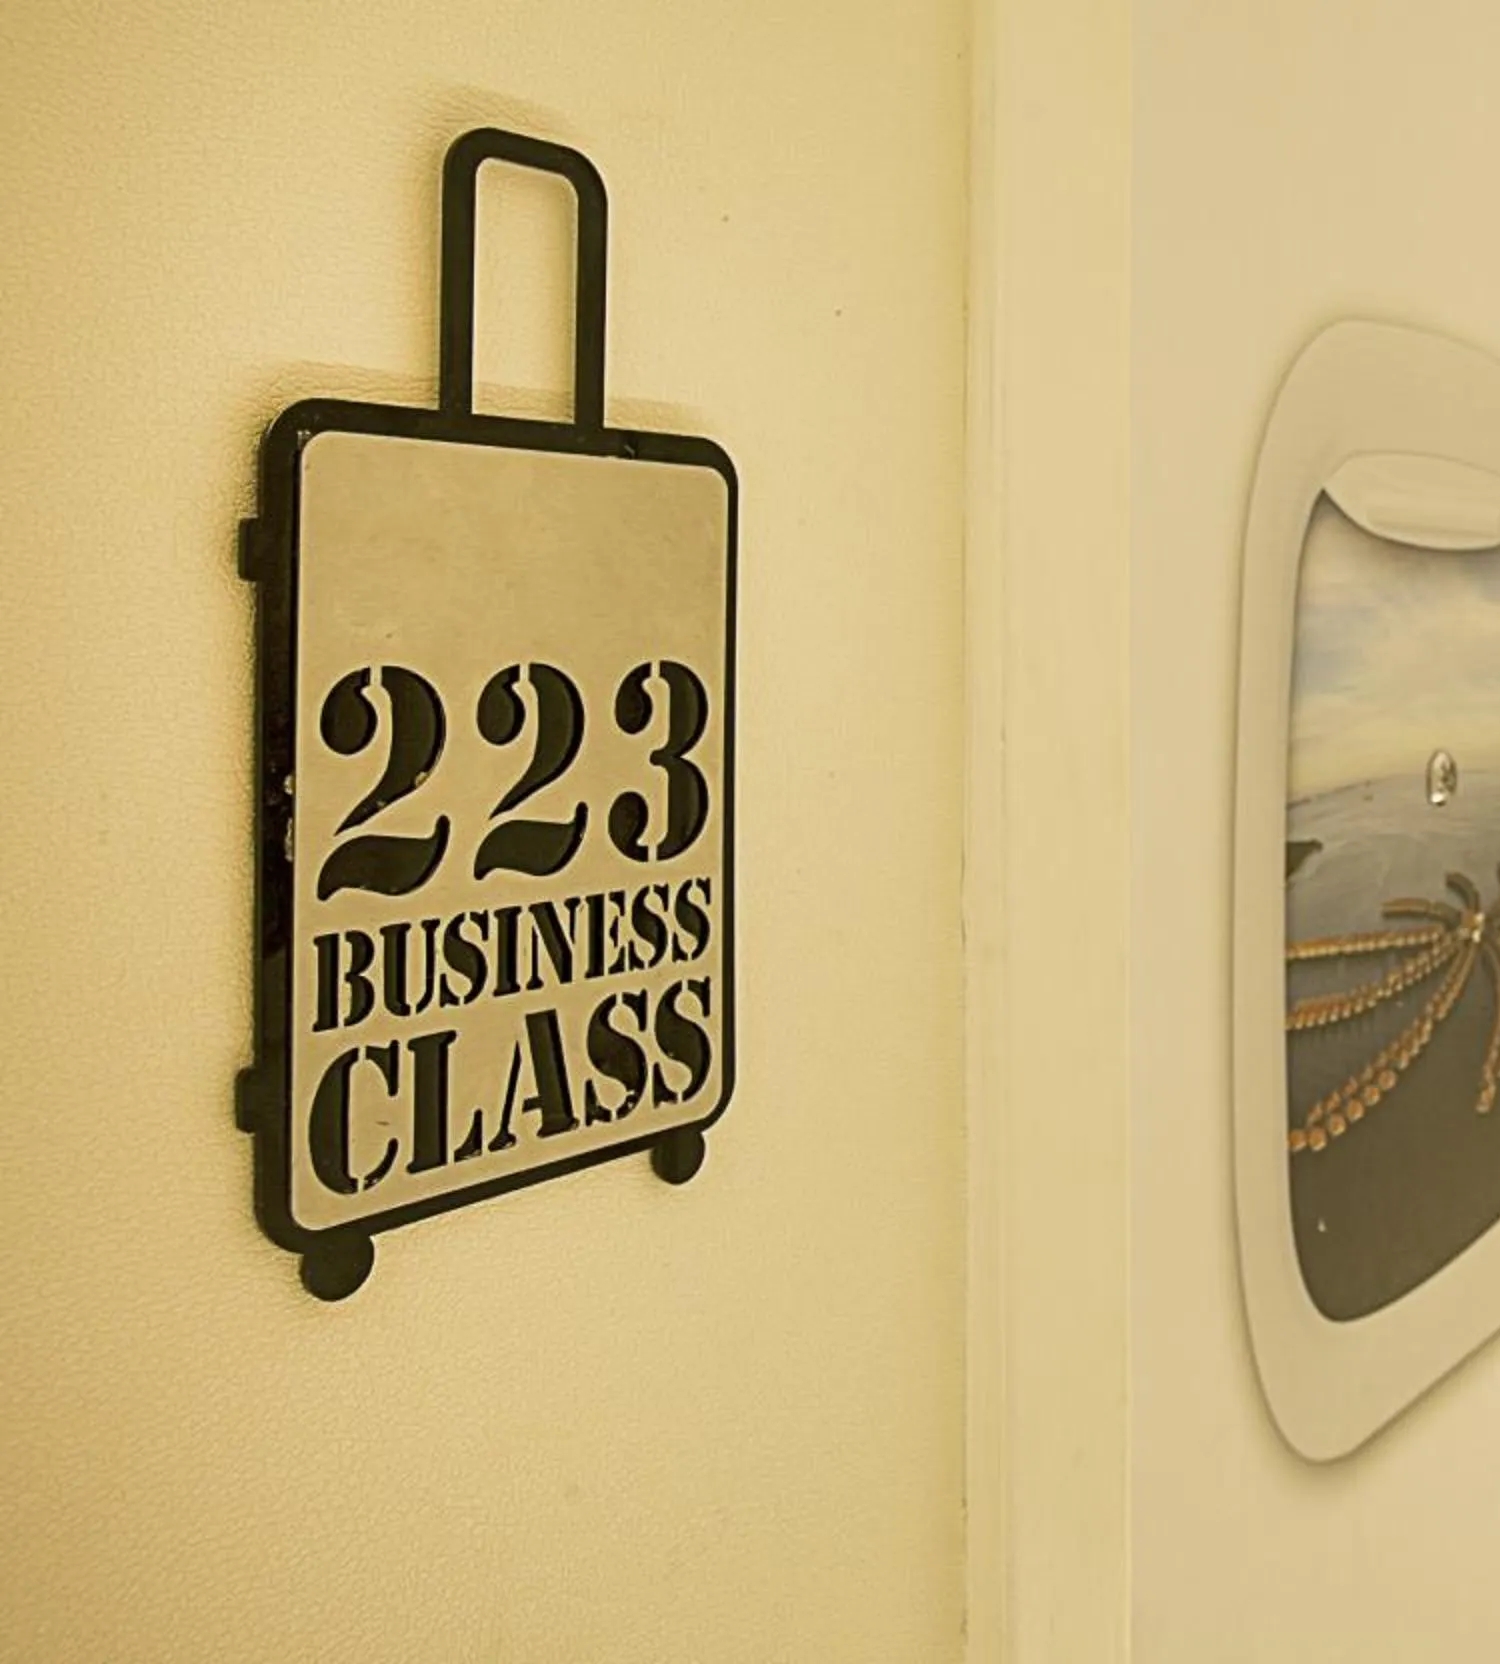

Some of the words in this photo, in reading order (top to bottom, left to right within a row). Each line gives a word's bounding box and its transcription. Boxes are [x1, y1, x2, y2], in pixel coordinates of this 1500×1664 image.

[316, 660, 709, 902] 223
[312, 877, 711, 1033] BUSINESS
[308, 976, 712, 1195] CLASS
